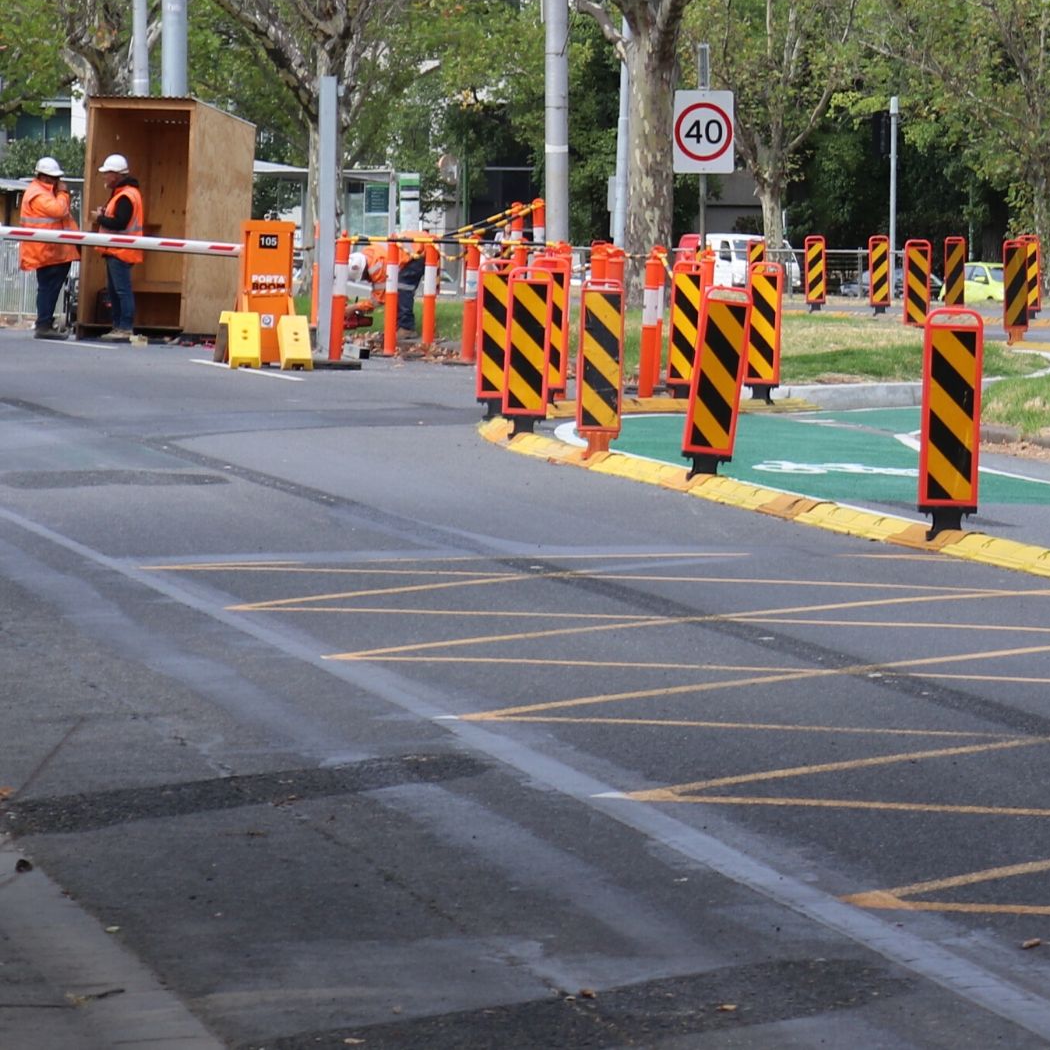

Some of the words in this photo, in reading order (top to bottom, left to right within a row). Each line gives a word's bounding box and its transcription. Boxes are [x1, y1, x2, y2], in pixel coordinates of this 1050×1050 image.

[684, 119, 723, 144] 40
[260, 236, 278, 246] 105
[251, 274, 285, 283] PORTA
